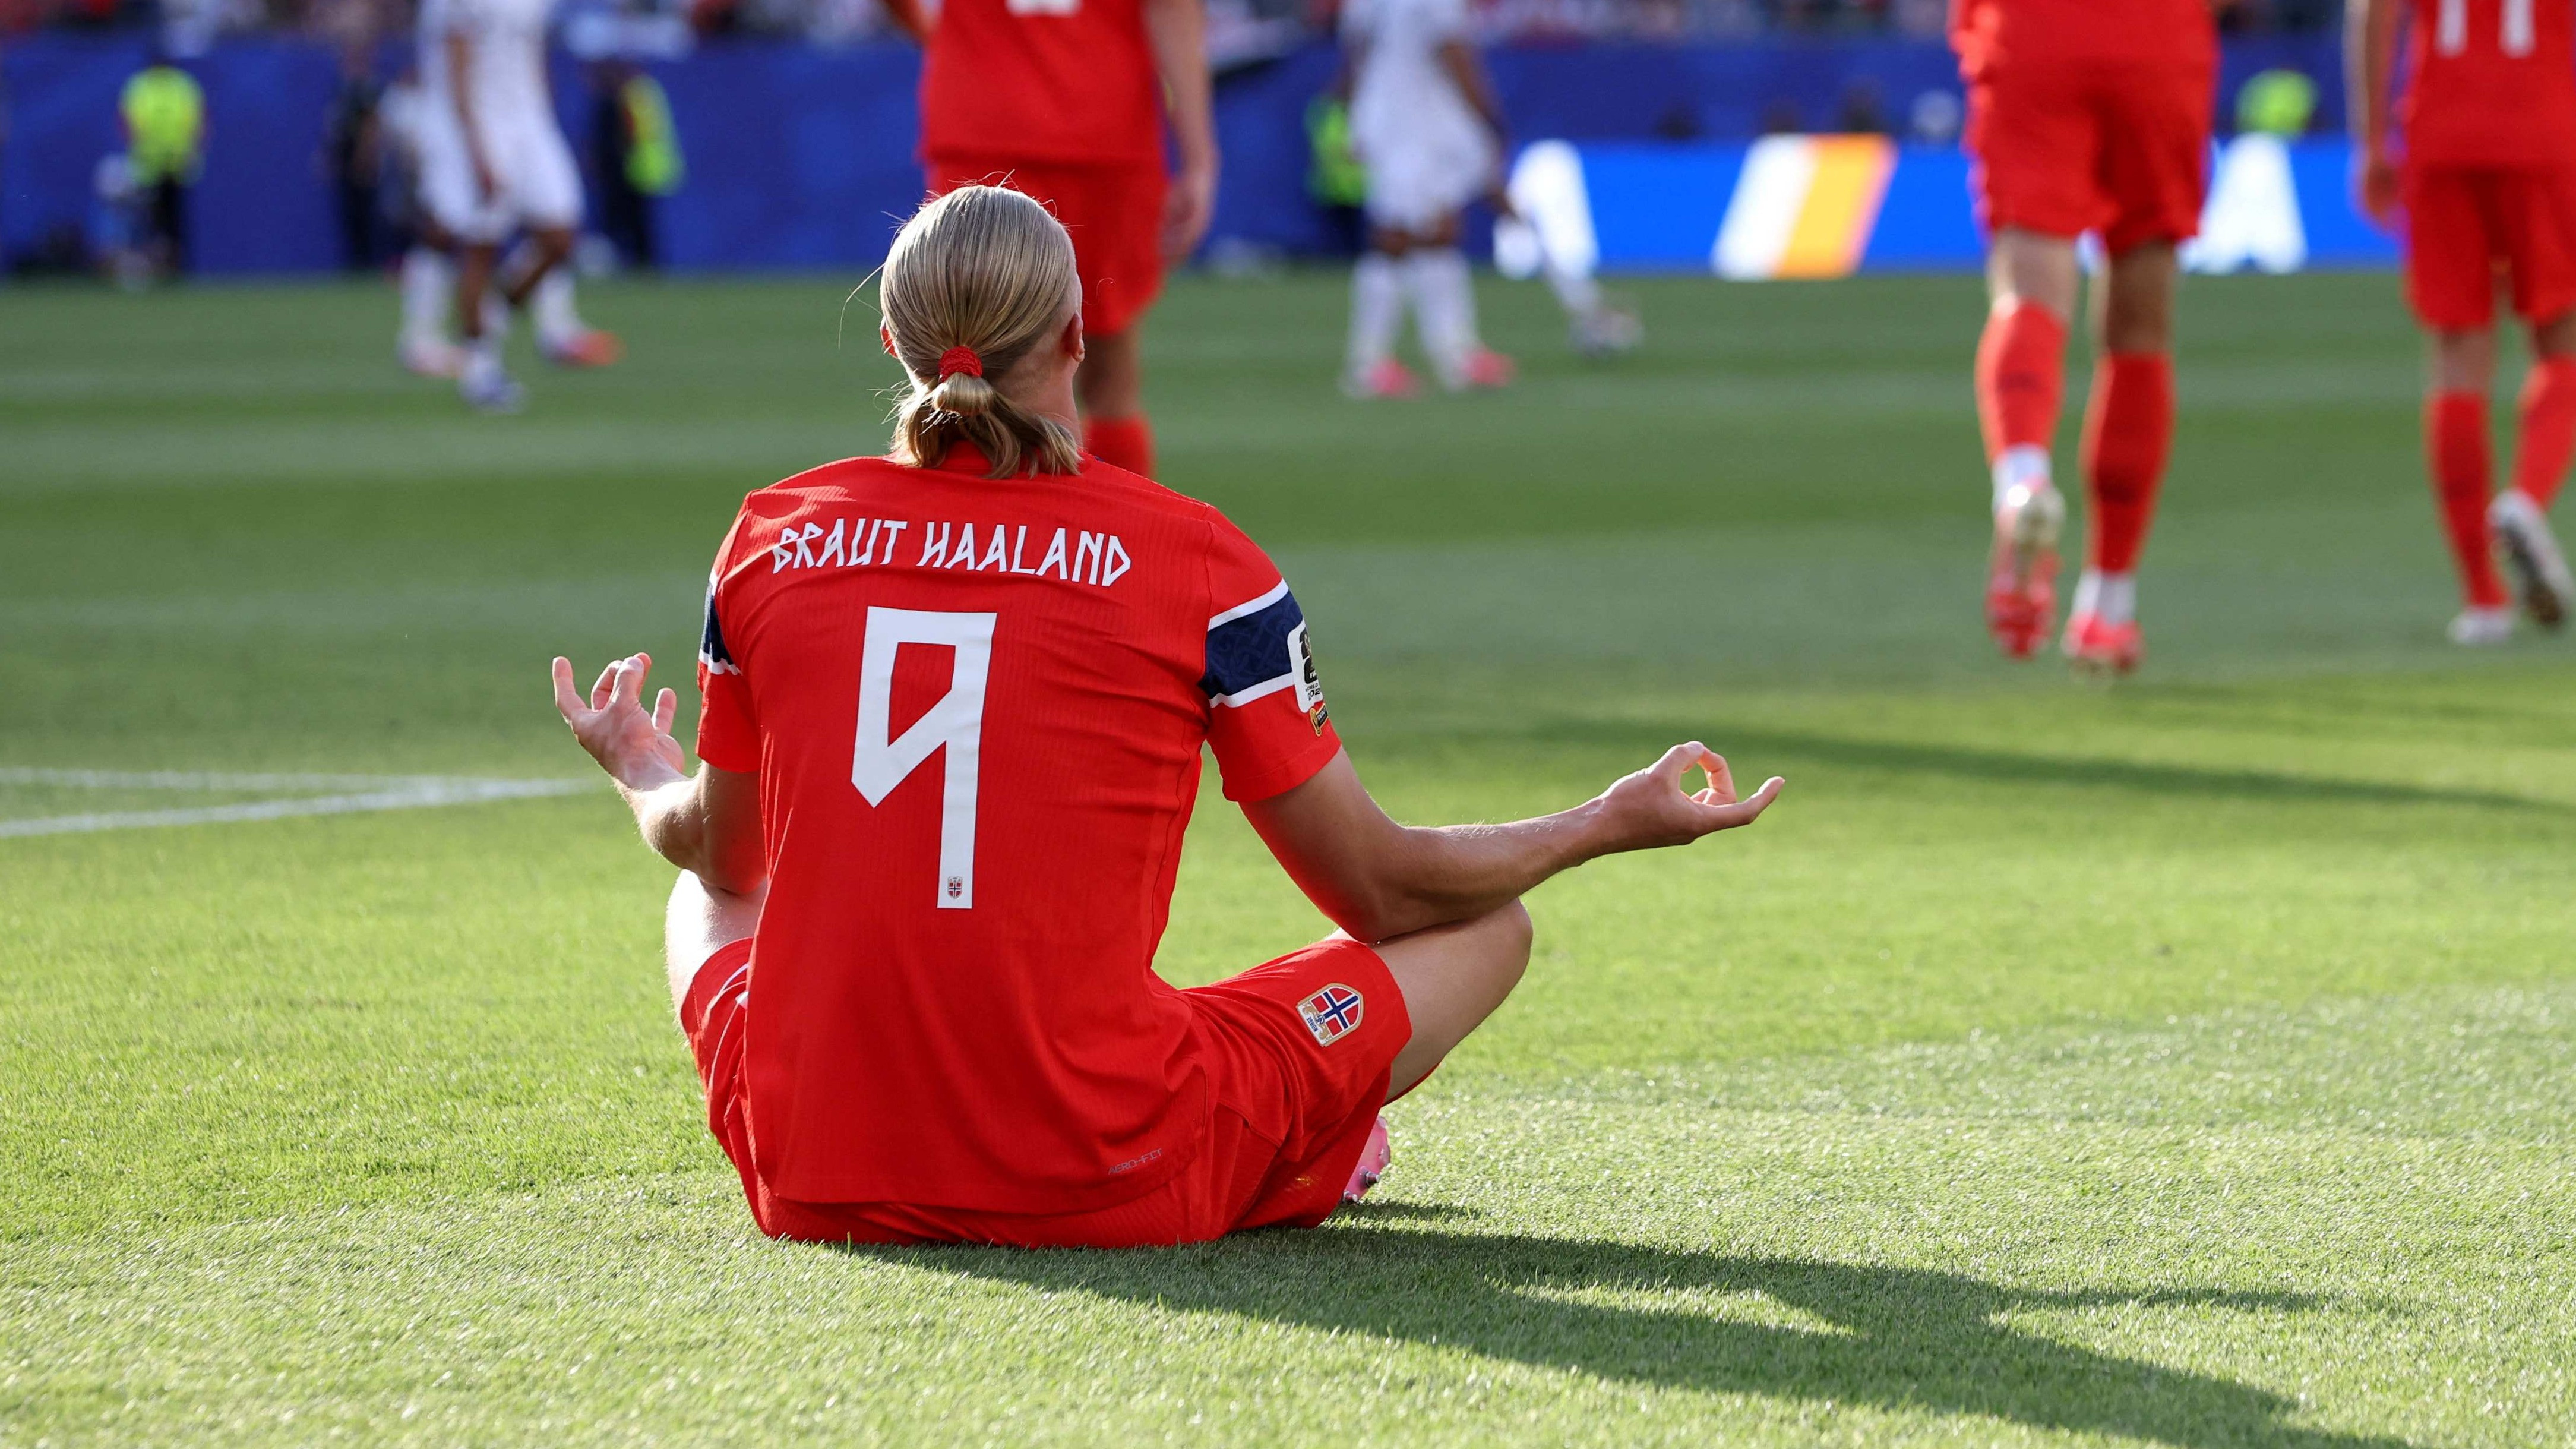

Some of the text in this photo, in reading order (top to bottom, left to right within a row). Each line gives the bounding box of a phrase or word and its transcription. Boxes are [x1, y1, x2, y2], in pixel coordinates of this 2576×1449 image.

[772, 518, 1131, 587] BRAUT HAALAND
[1307, 687, 1321, 701] 202
[851, 605, 998, 910] 9
